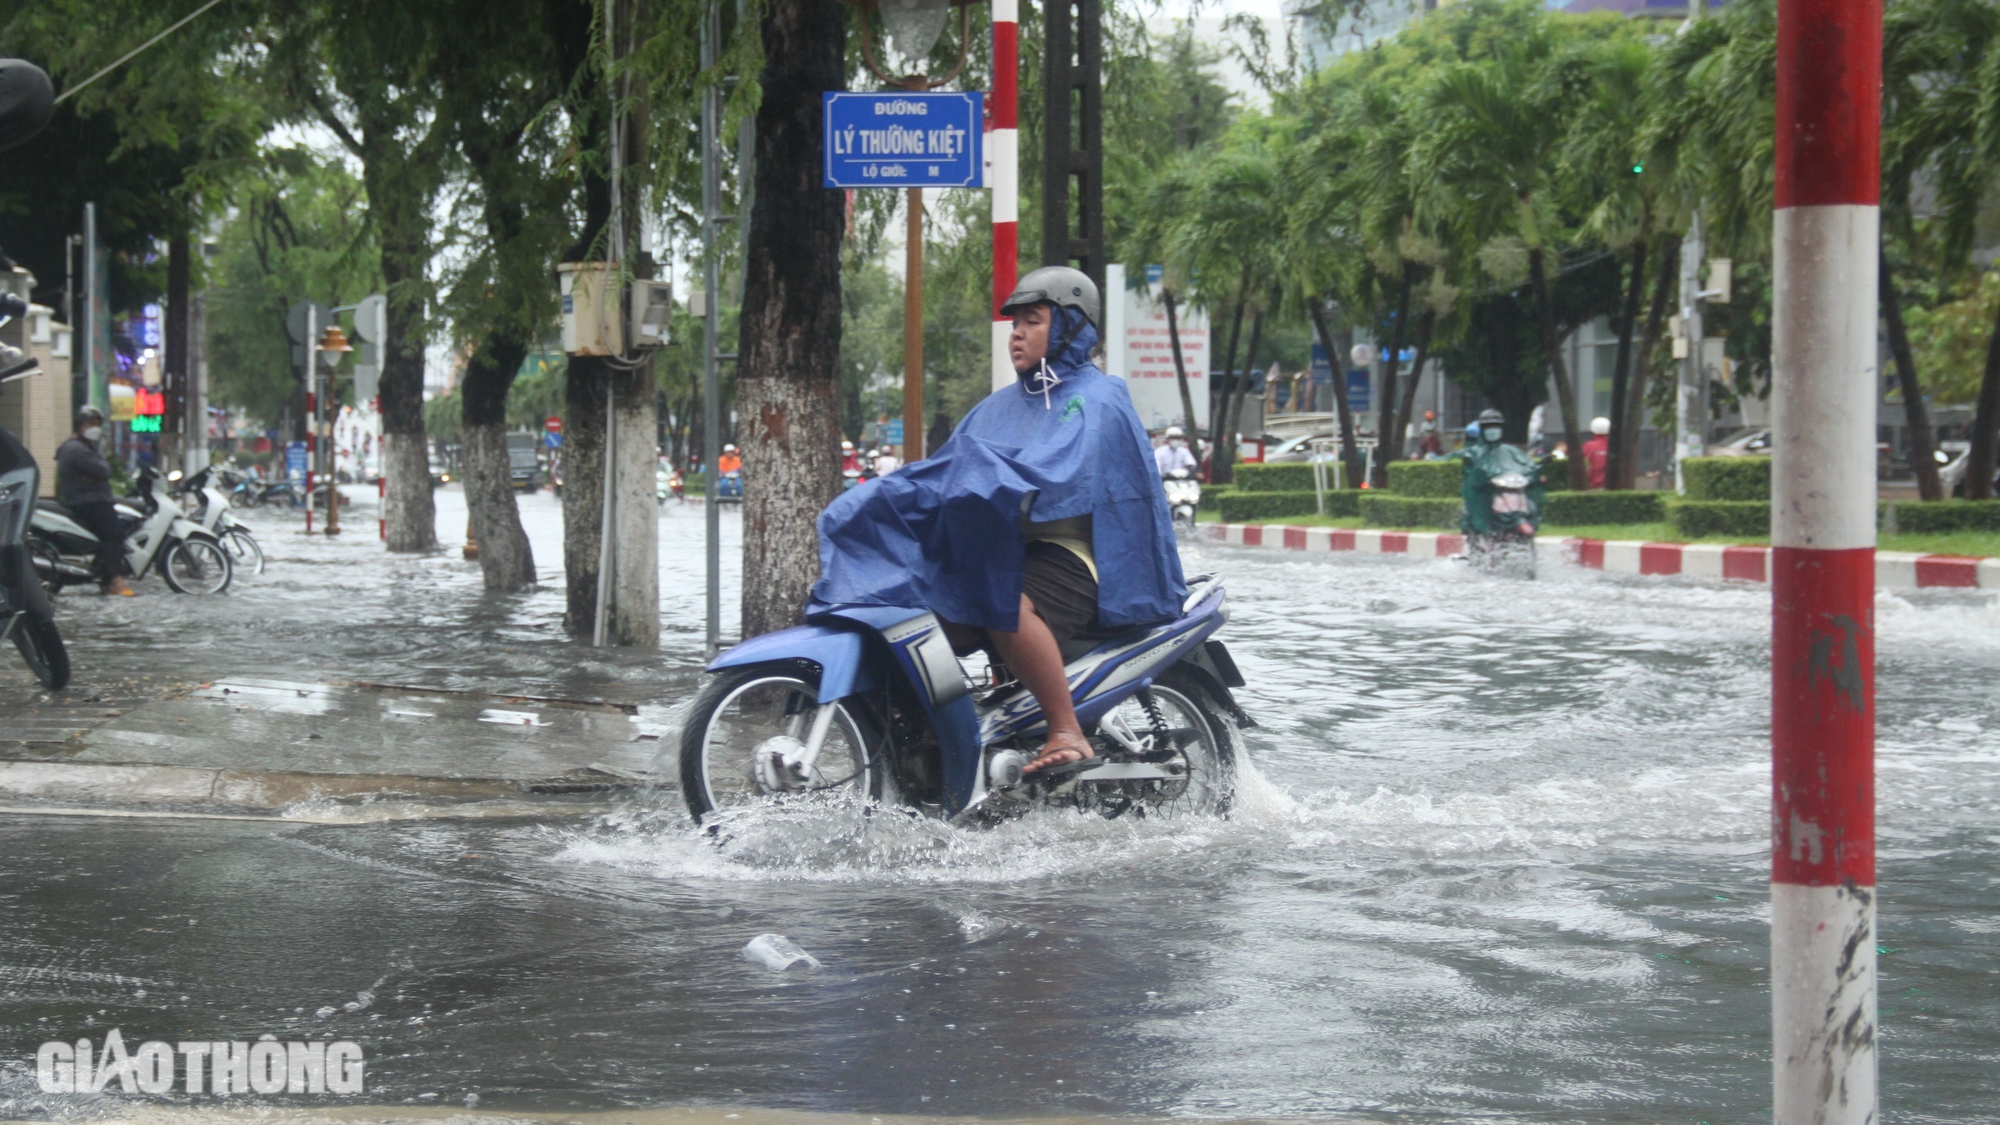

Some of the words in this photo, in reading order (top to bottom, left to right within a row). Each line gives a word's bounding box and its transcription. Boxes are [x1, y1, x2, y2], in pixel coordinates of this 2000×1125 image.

[874, 98, 928, 116] ĐƯỜNG
[834, 124, 855, 155] LÝ
[928, 124, 966, 159] KIỆT
[862, 163, 878, 179] LỘ
[928, 165, 940, 177] M
